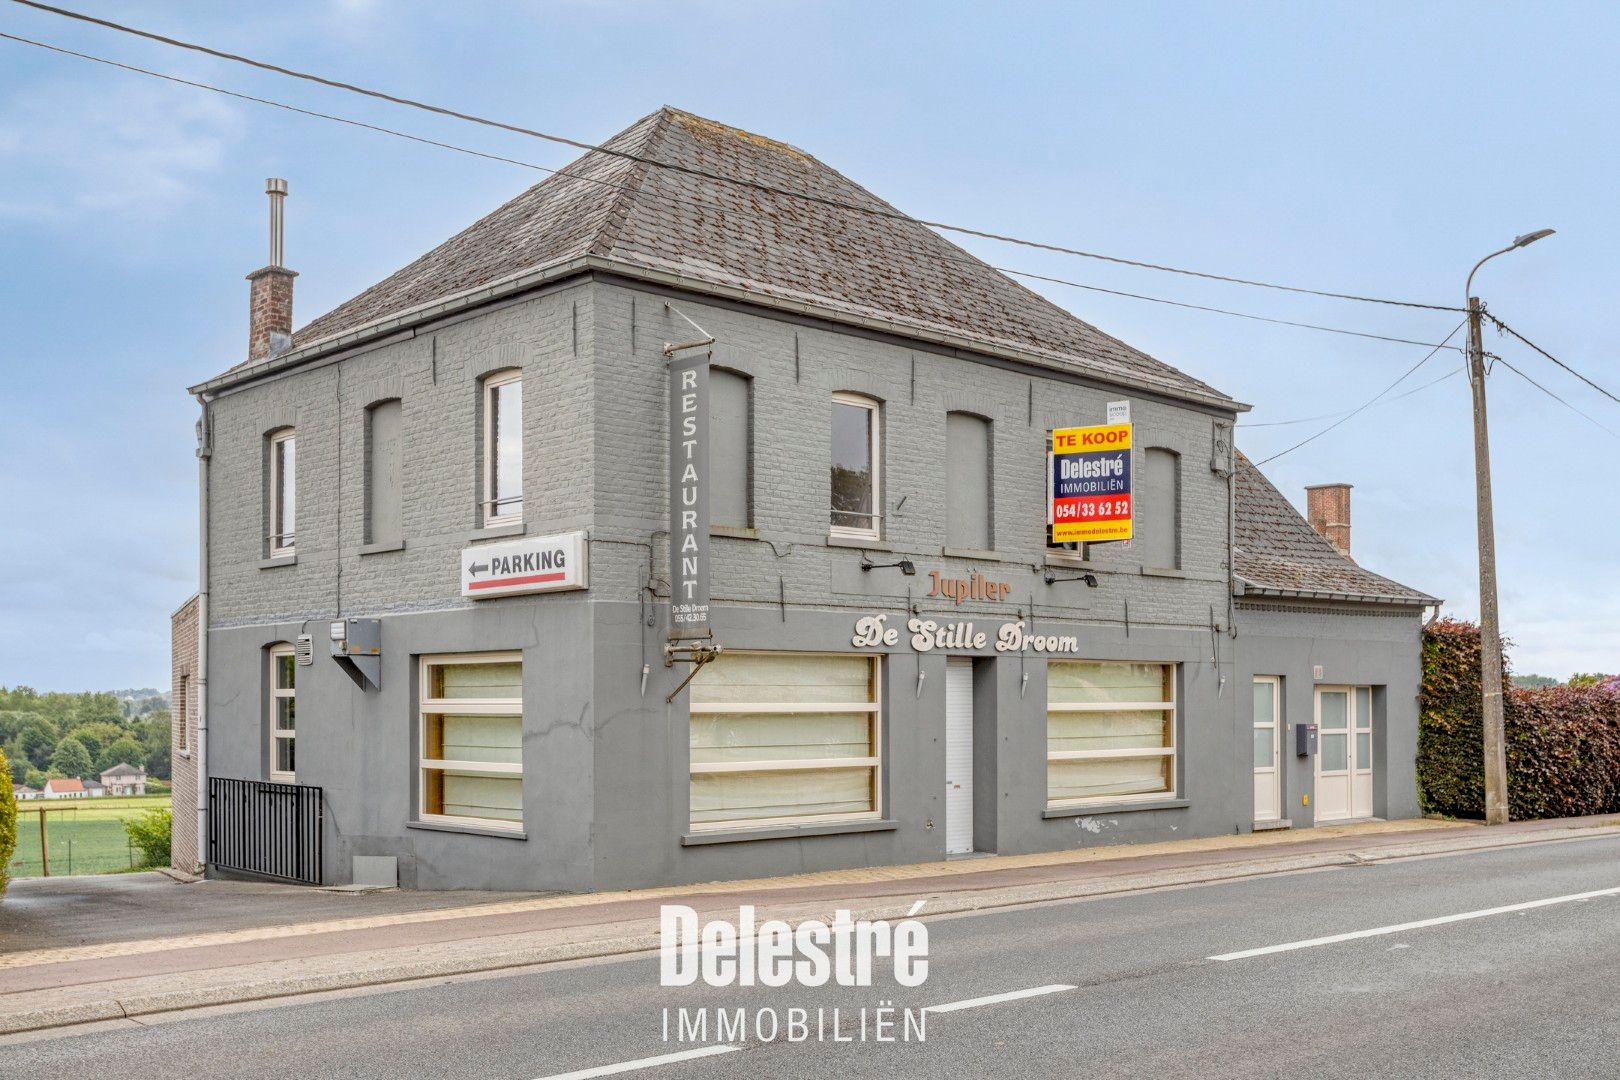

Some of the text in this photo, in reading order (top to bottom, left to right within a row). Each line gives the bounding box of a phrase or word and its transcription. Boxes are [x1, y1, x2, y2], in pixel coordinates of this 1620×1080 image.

[1056, 430, 1128, 448] TE KOOP
[1060, 453, 1123, 480] Delestré
[681, 369, 698, 599] RESTAURANT
[1060, 479, 1124, 494] IMMOBILIËN
[1056, 500, 1128, 518] 054/33 62 52
[492, 549, 565, 575] PARKING
[927, 570, 1011, 605] Jupiler
[672, 605, 679, 613] De
[852, 614, 1079, 653] De Stille Droom
